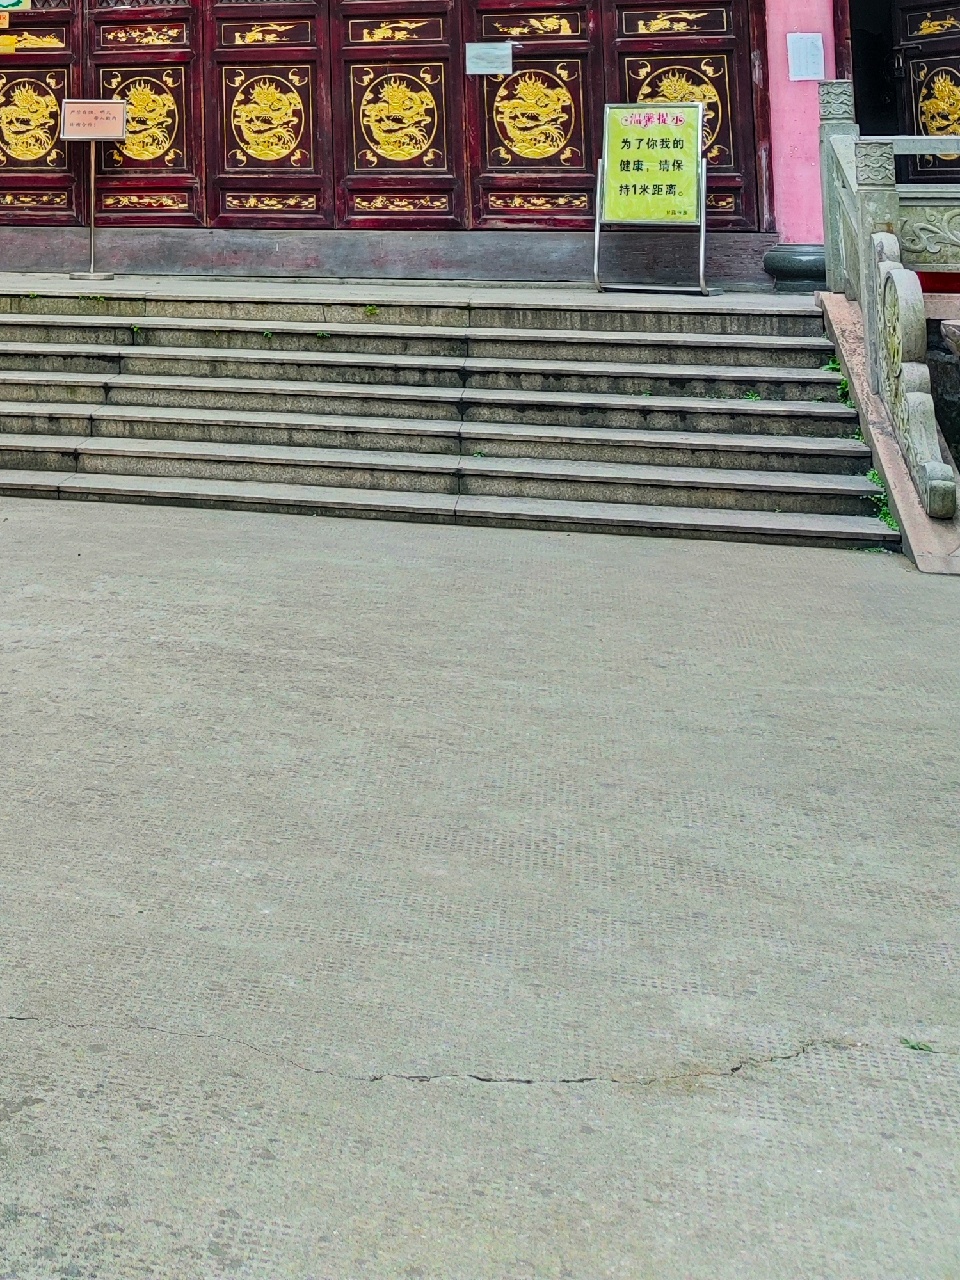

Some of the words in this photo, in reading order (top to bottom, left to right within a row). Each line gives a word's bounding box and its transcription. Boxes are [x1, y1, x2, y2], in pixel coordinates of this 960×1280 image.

[629, 112, 683, 128] 温馨提示
[621, 138, 684, 150] 为了你我的
